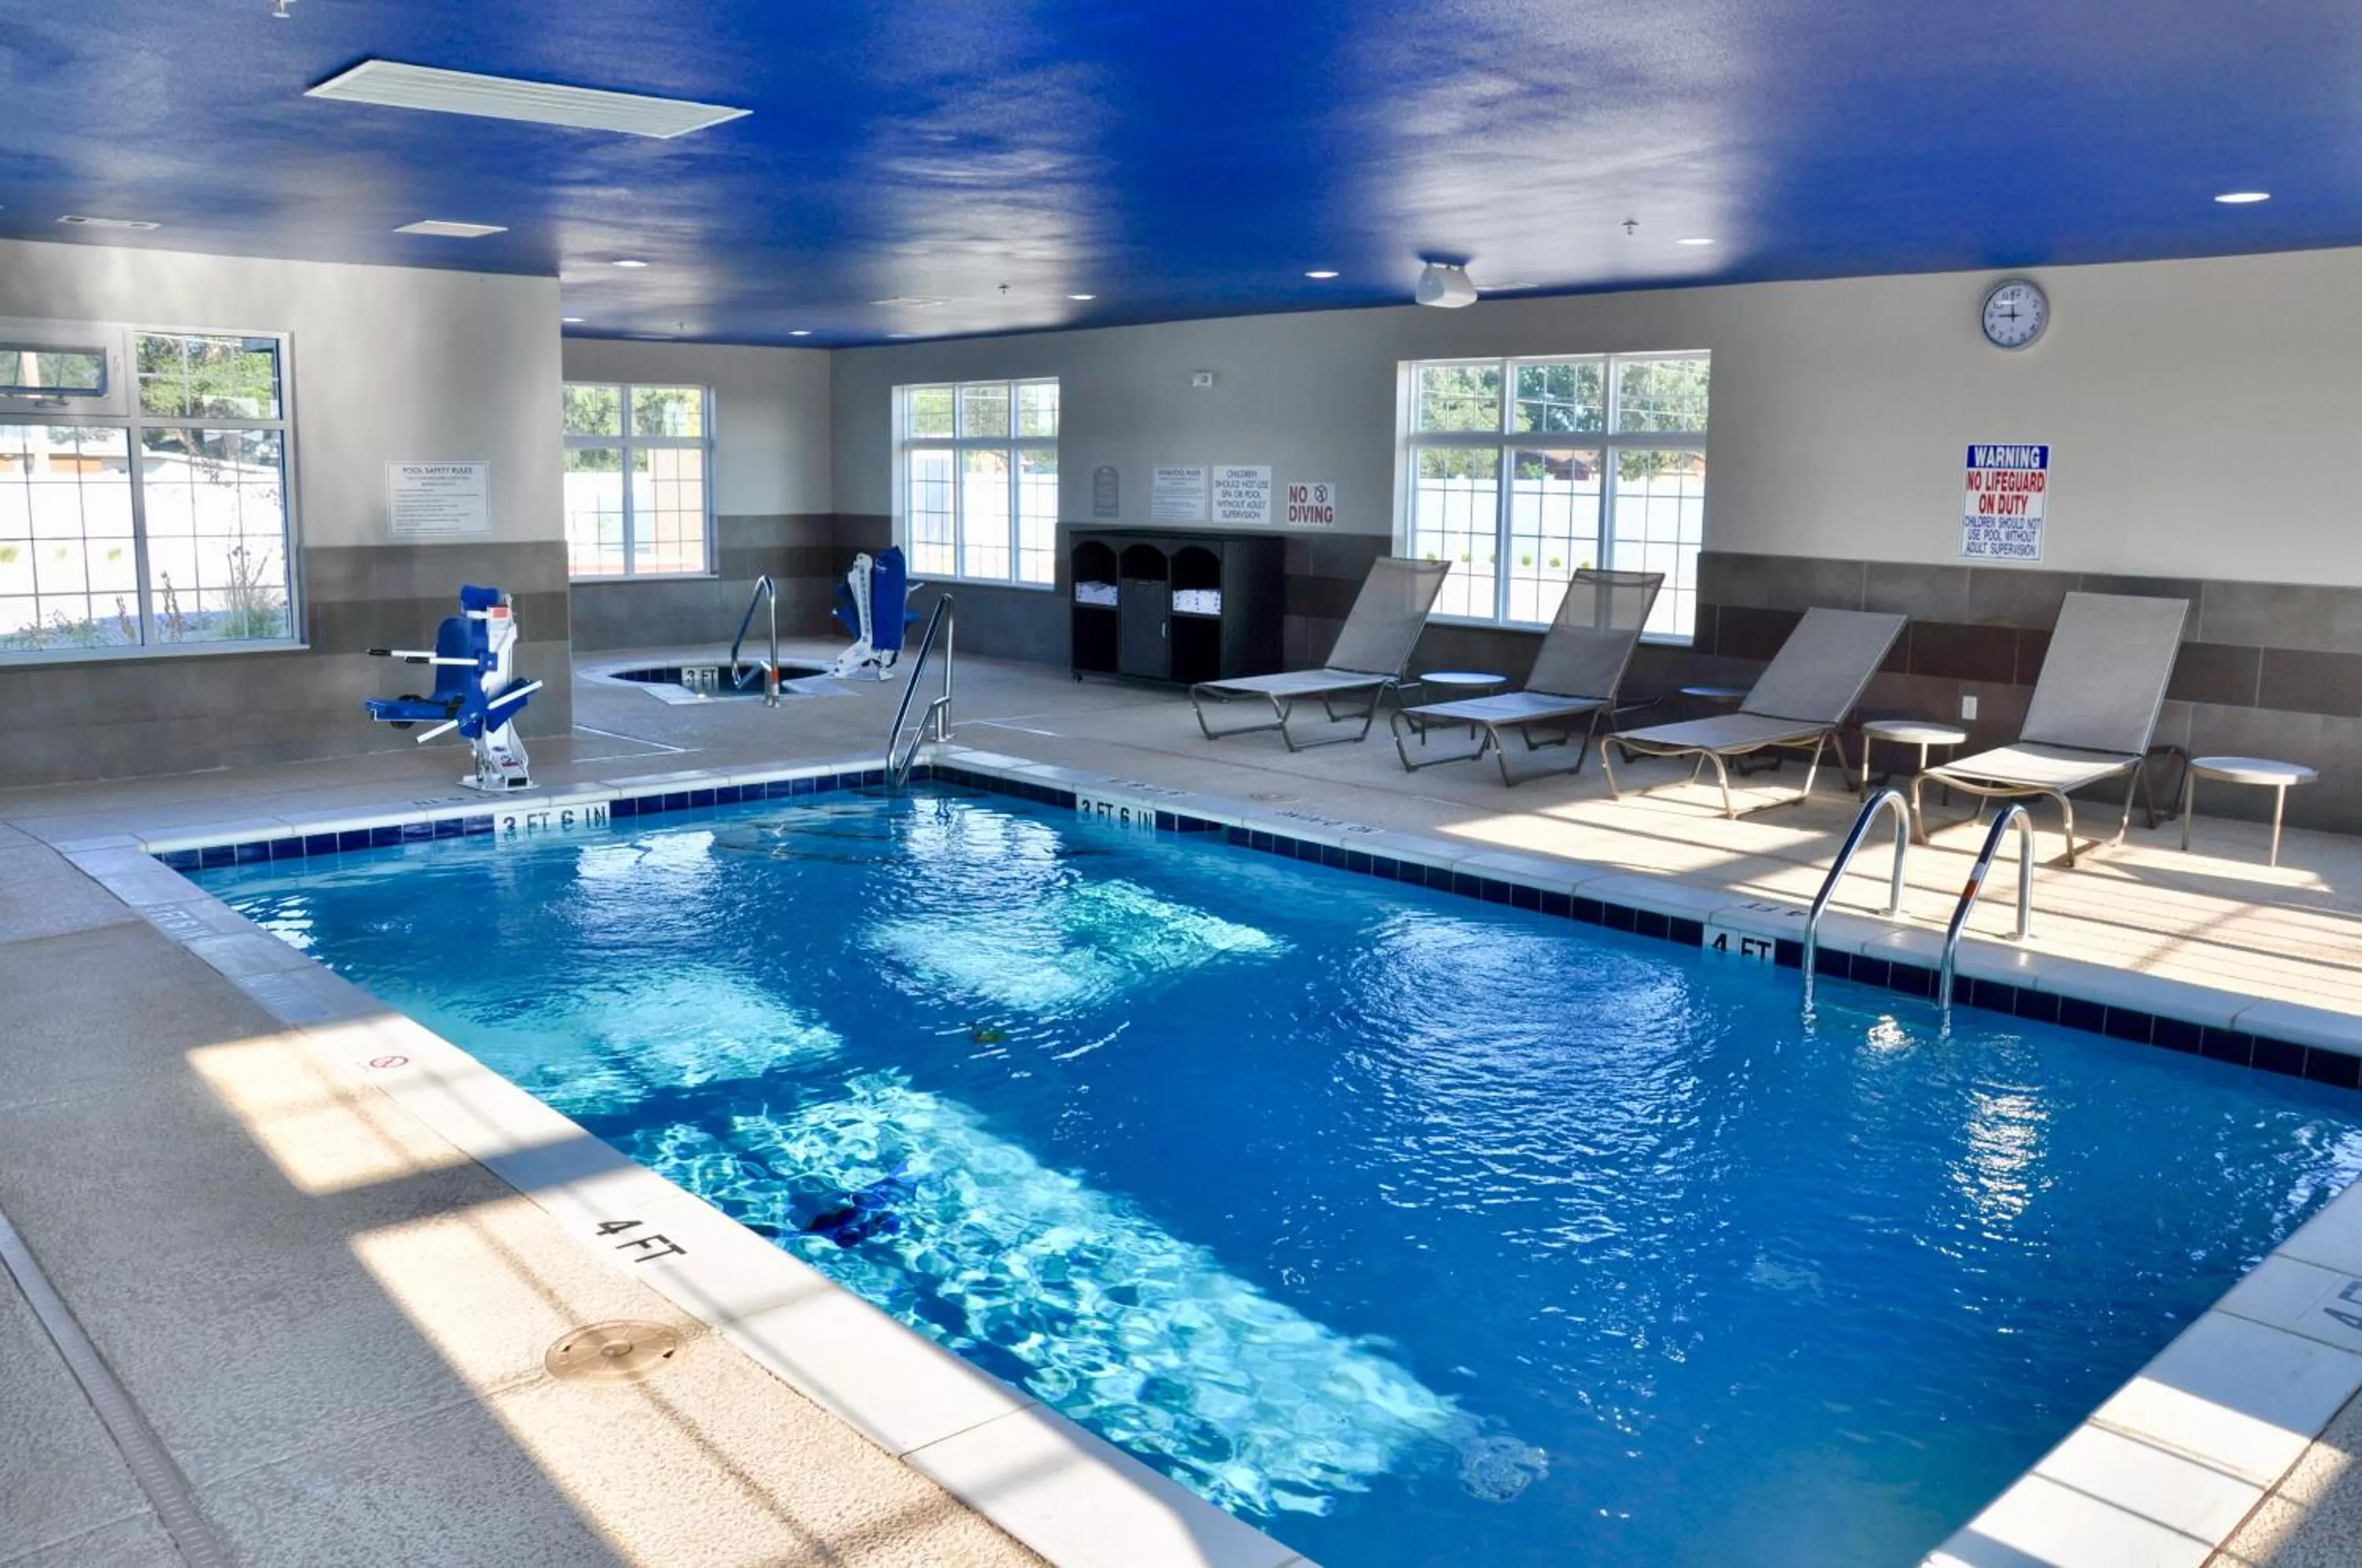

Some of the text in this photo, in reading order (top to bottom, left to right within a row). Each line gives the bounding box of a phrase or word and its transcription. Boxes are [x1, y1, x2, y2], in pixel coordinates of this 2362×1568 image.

[1975, 446, 2040, 468] WARNING
[1965, 471, 2045, 493] NO LIFEGUARD
[1289, 486, 1308, 504] NO
[1979, 494, 2029, 515] ON DUTY
[1289, 505, 1334, 523] DIVING
[1964, 516, 2042, 530] CHILDREN SHOULD NOT
[1968, 529, 2037, 542] USE POOL WITHOUT
[1966, 542, 2036, 556] ADULT SUPERVISION
[526, 812, 551, 832] FT
[585, 805, 606, 827] IN
[1097, 801, 1114, 819] FT
[1138, 809, 1153, 827] IN
[1712, 932, 1772, 960] 4 FT
[595, 1220, 688, 1263] 4 FT
